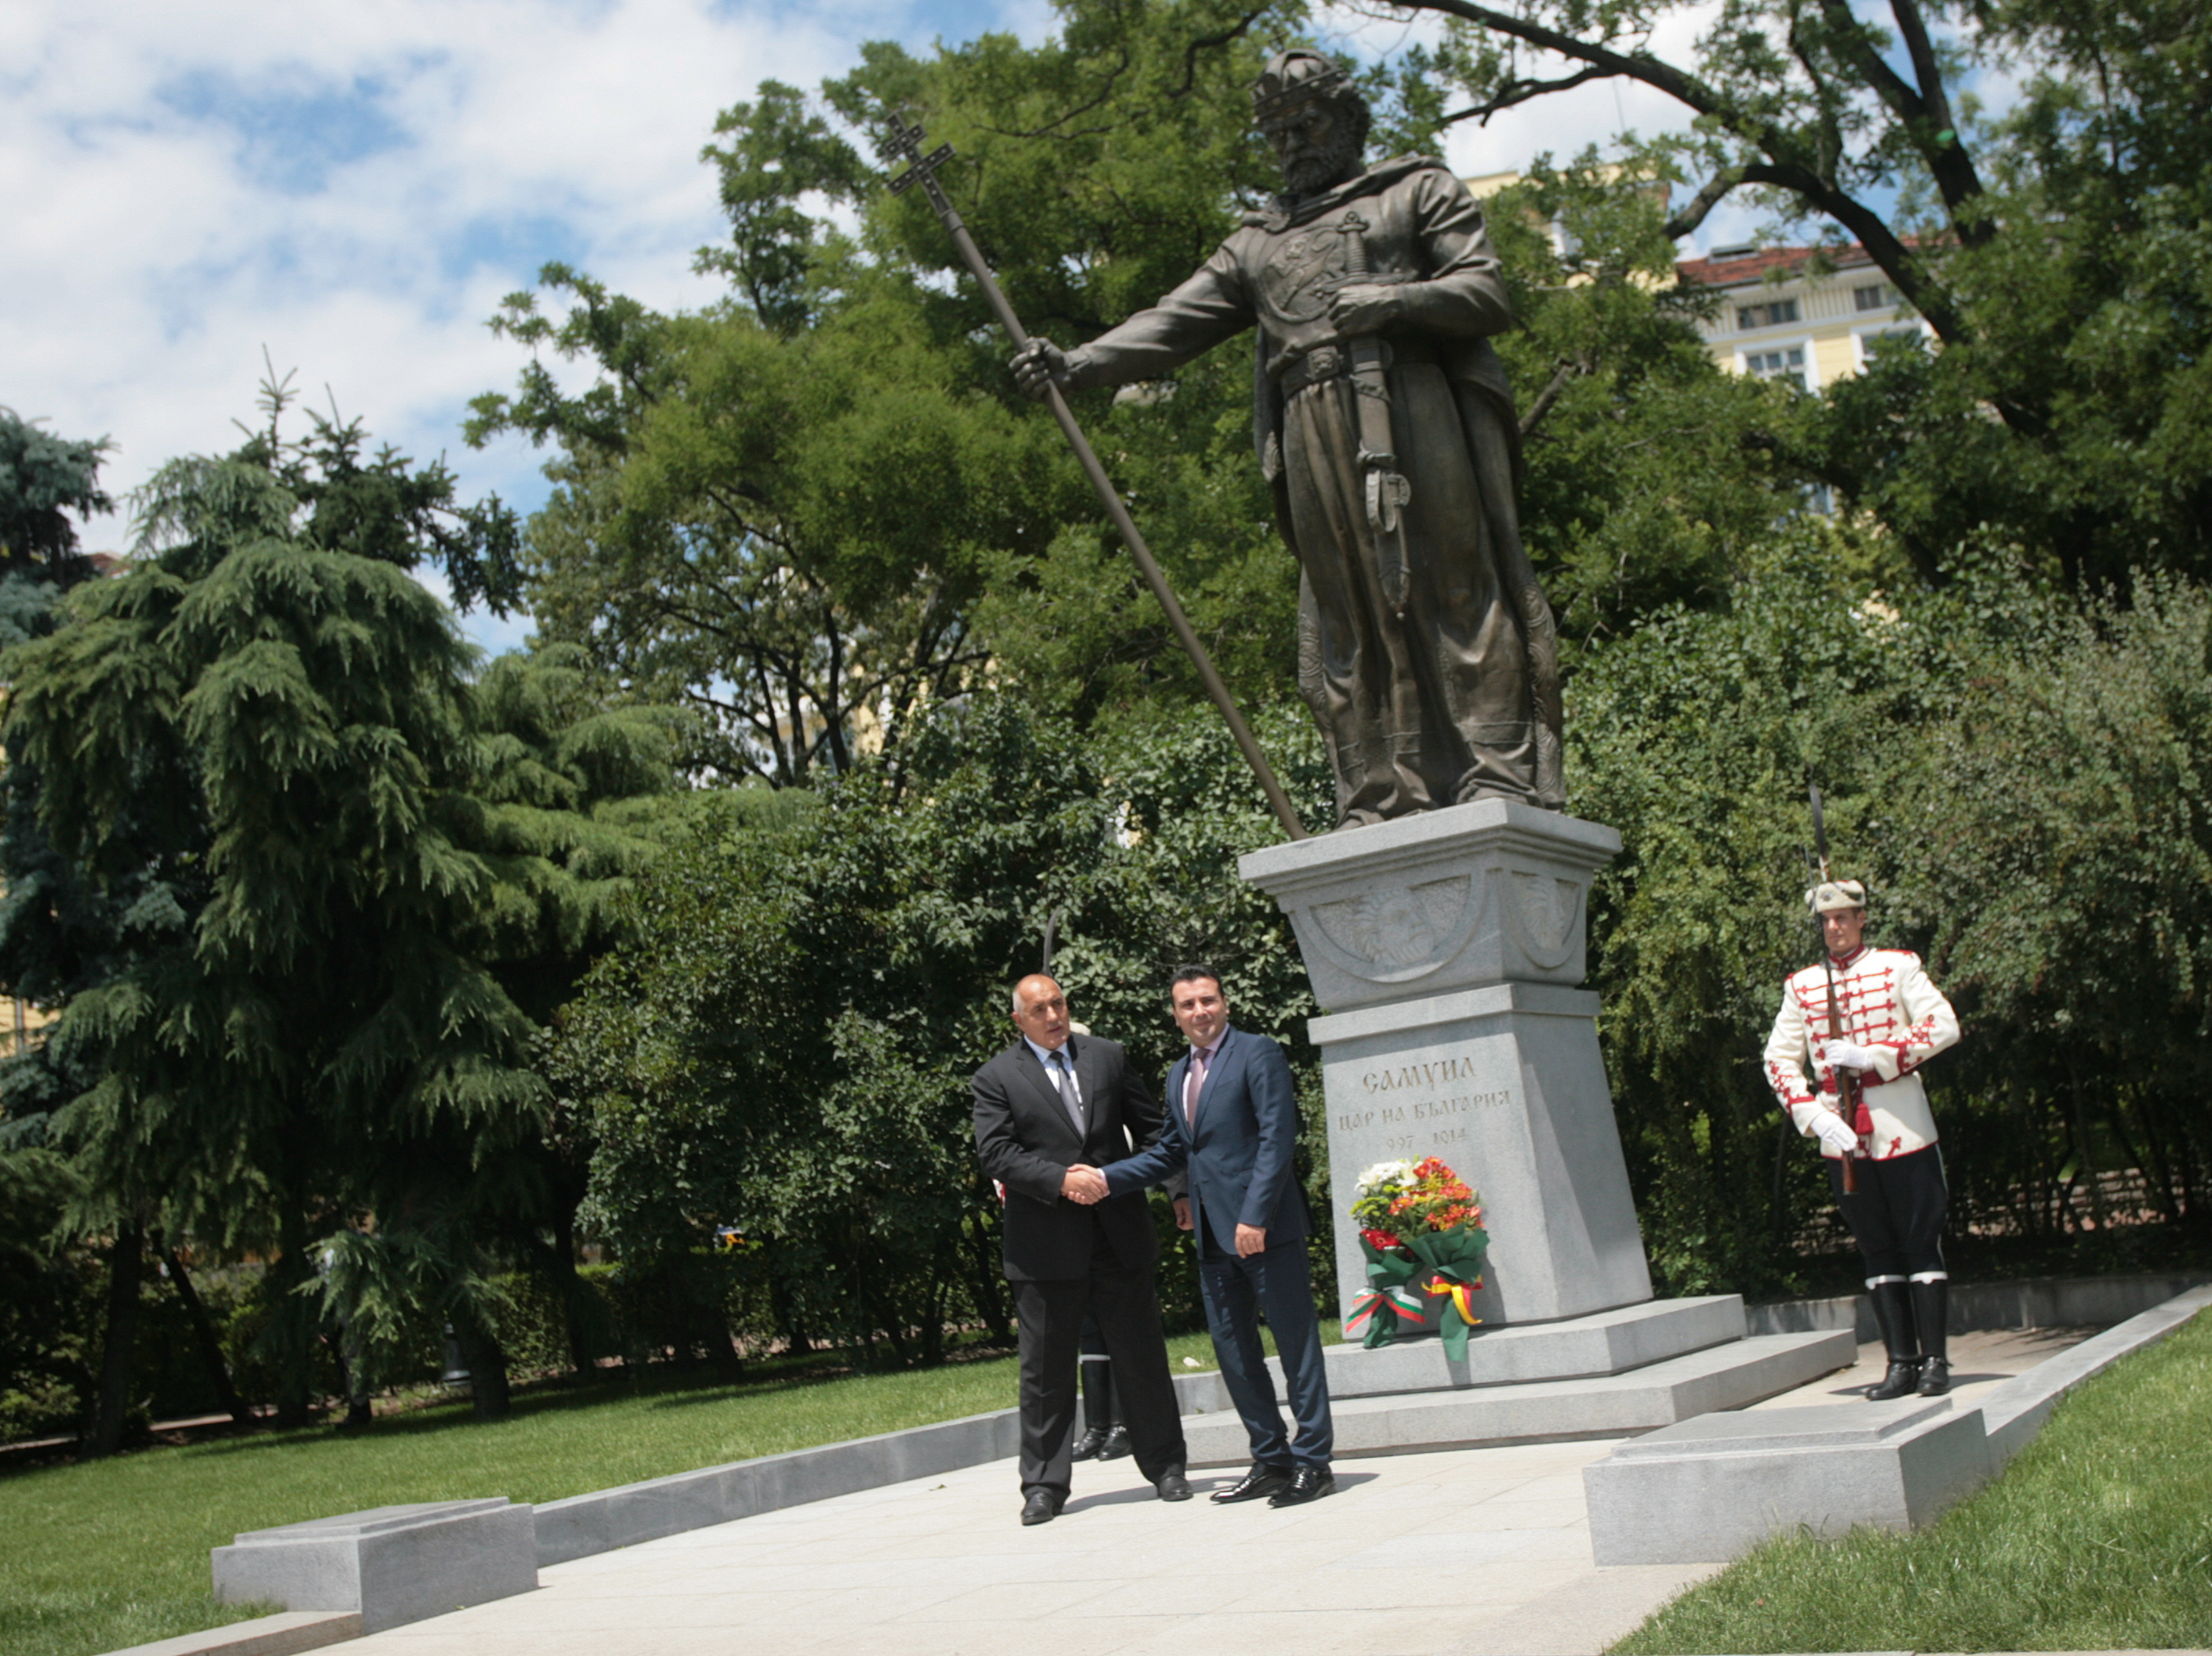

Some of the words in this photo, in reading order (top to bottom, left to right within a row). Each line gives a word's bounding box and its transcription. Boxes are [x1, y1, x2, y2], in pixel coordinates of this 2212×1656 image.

[1363, 1056, 1477, 1095] САМУИЛ
[1338, 1111, 1375, 1131] ЦАР
[1382, 1106, 1406, 1124] НА
[1414, 1089, 1511, 1119] БЪЛГАРИЯ
[1386, 1135, 1414, 1151] 997
[1432, 1128, 1468, 1145] 1014
